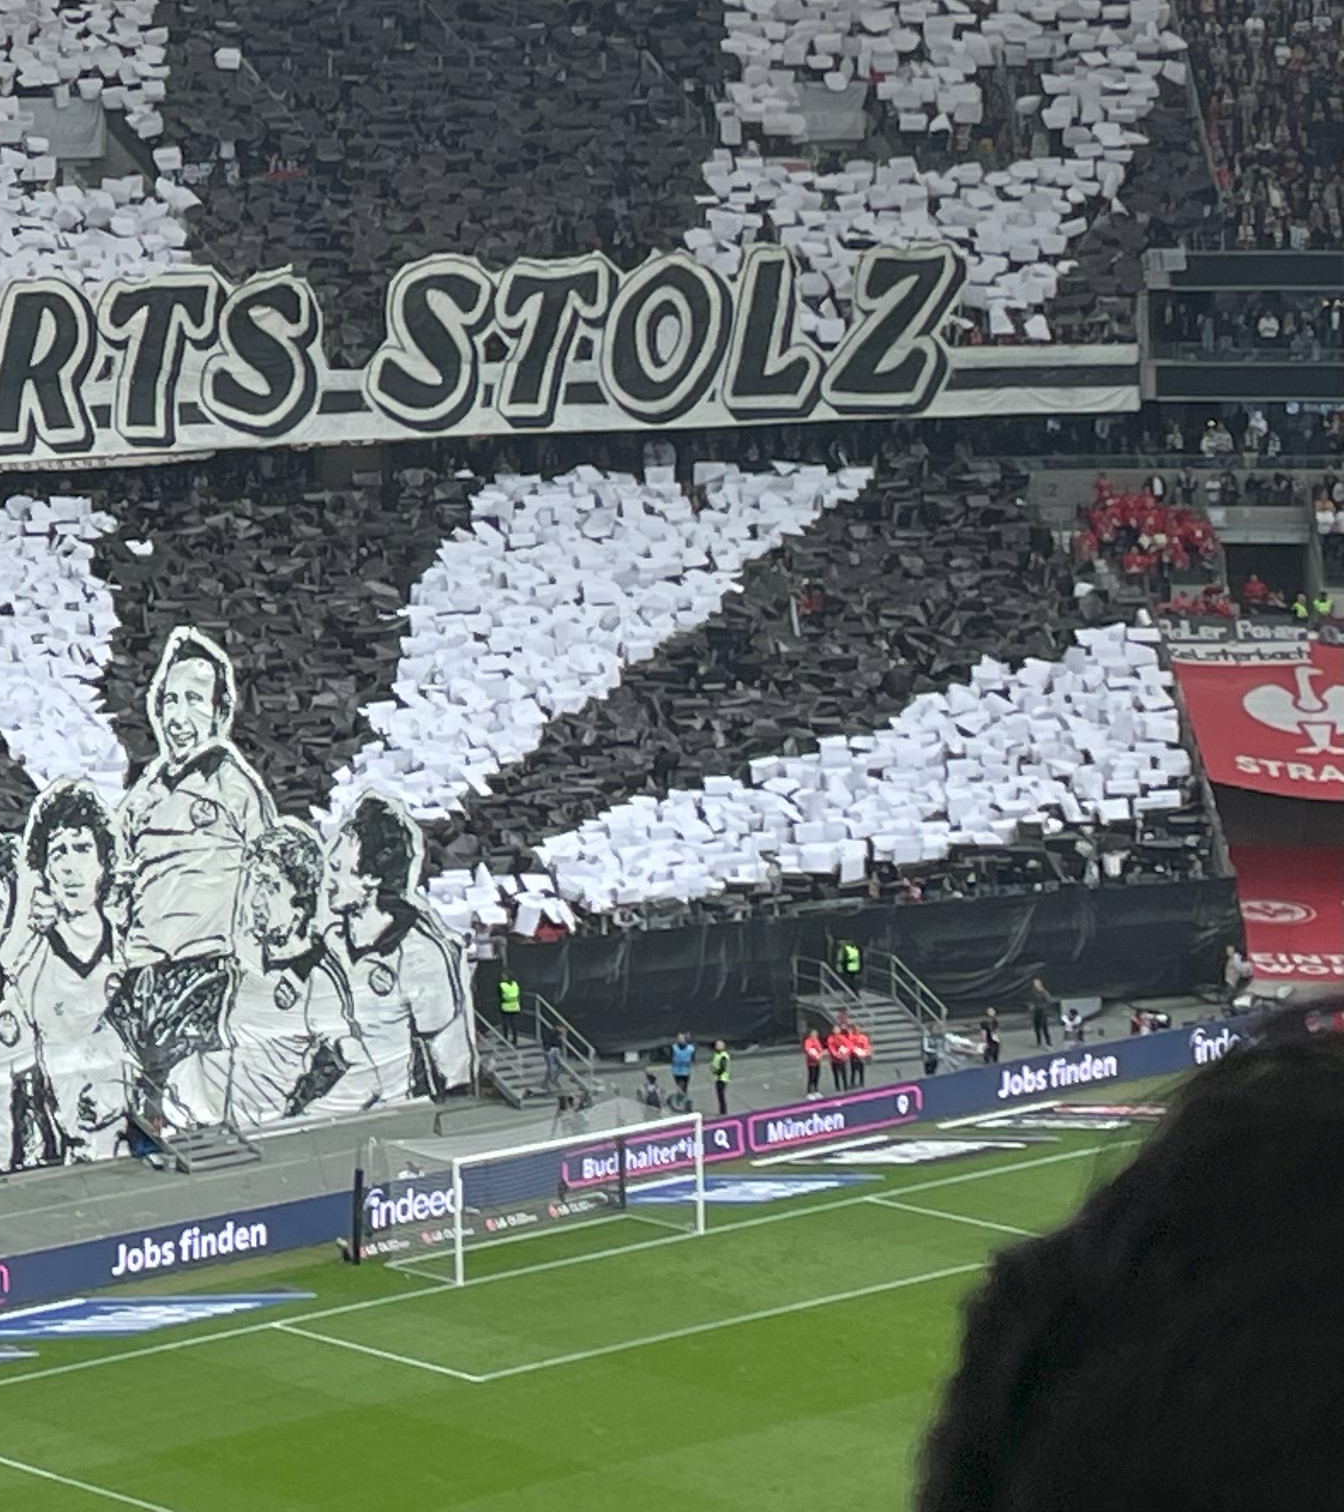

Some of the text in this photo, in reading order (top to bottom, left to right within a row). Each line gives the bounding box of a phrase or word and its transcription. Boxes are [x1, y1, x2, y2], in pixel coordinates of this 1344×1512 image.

[365, 242, 965, 430] STOLZ
[998, 1053, 1117, 1099] Jobs finden
[765, 1110, 844, 1144] München
[111, 1220, 267, 1276] Jobs finden
